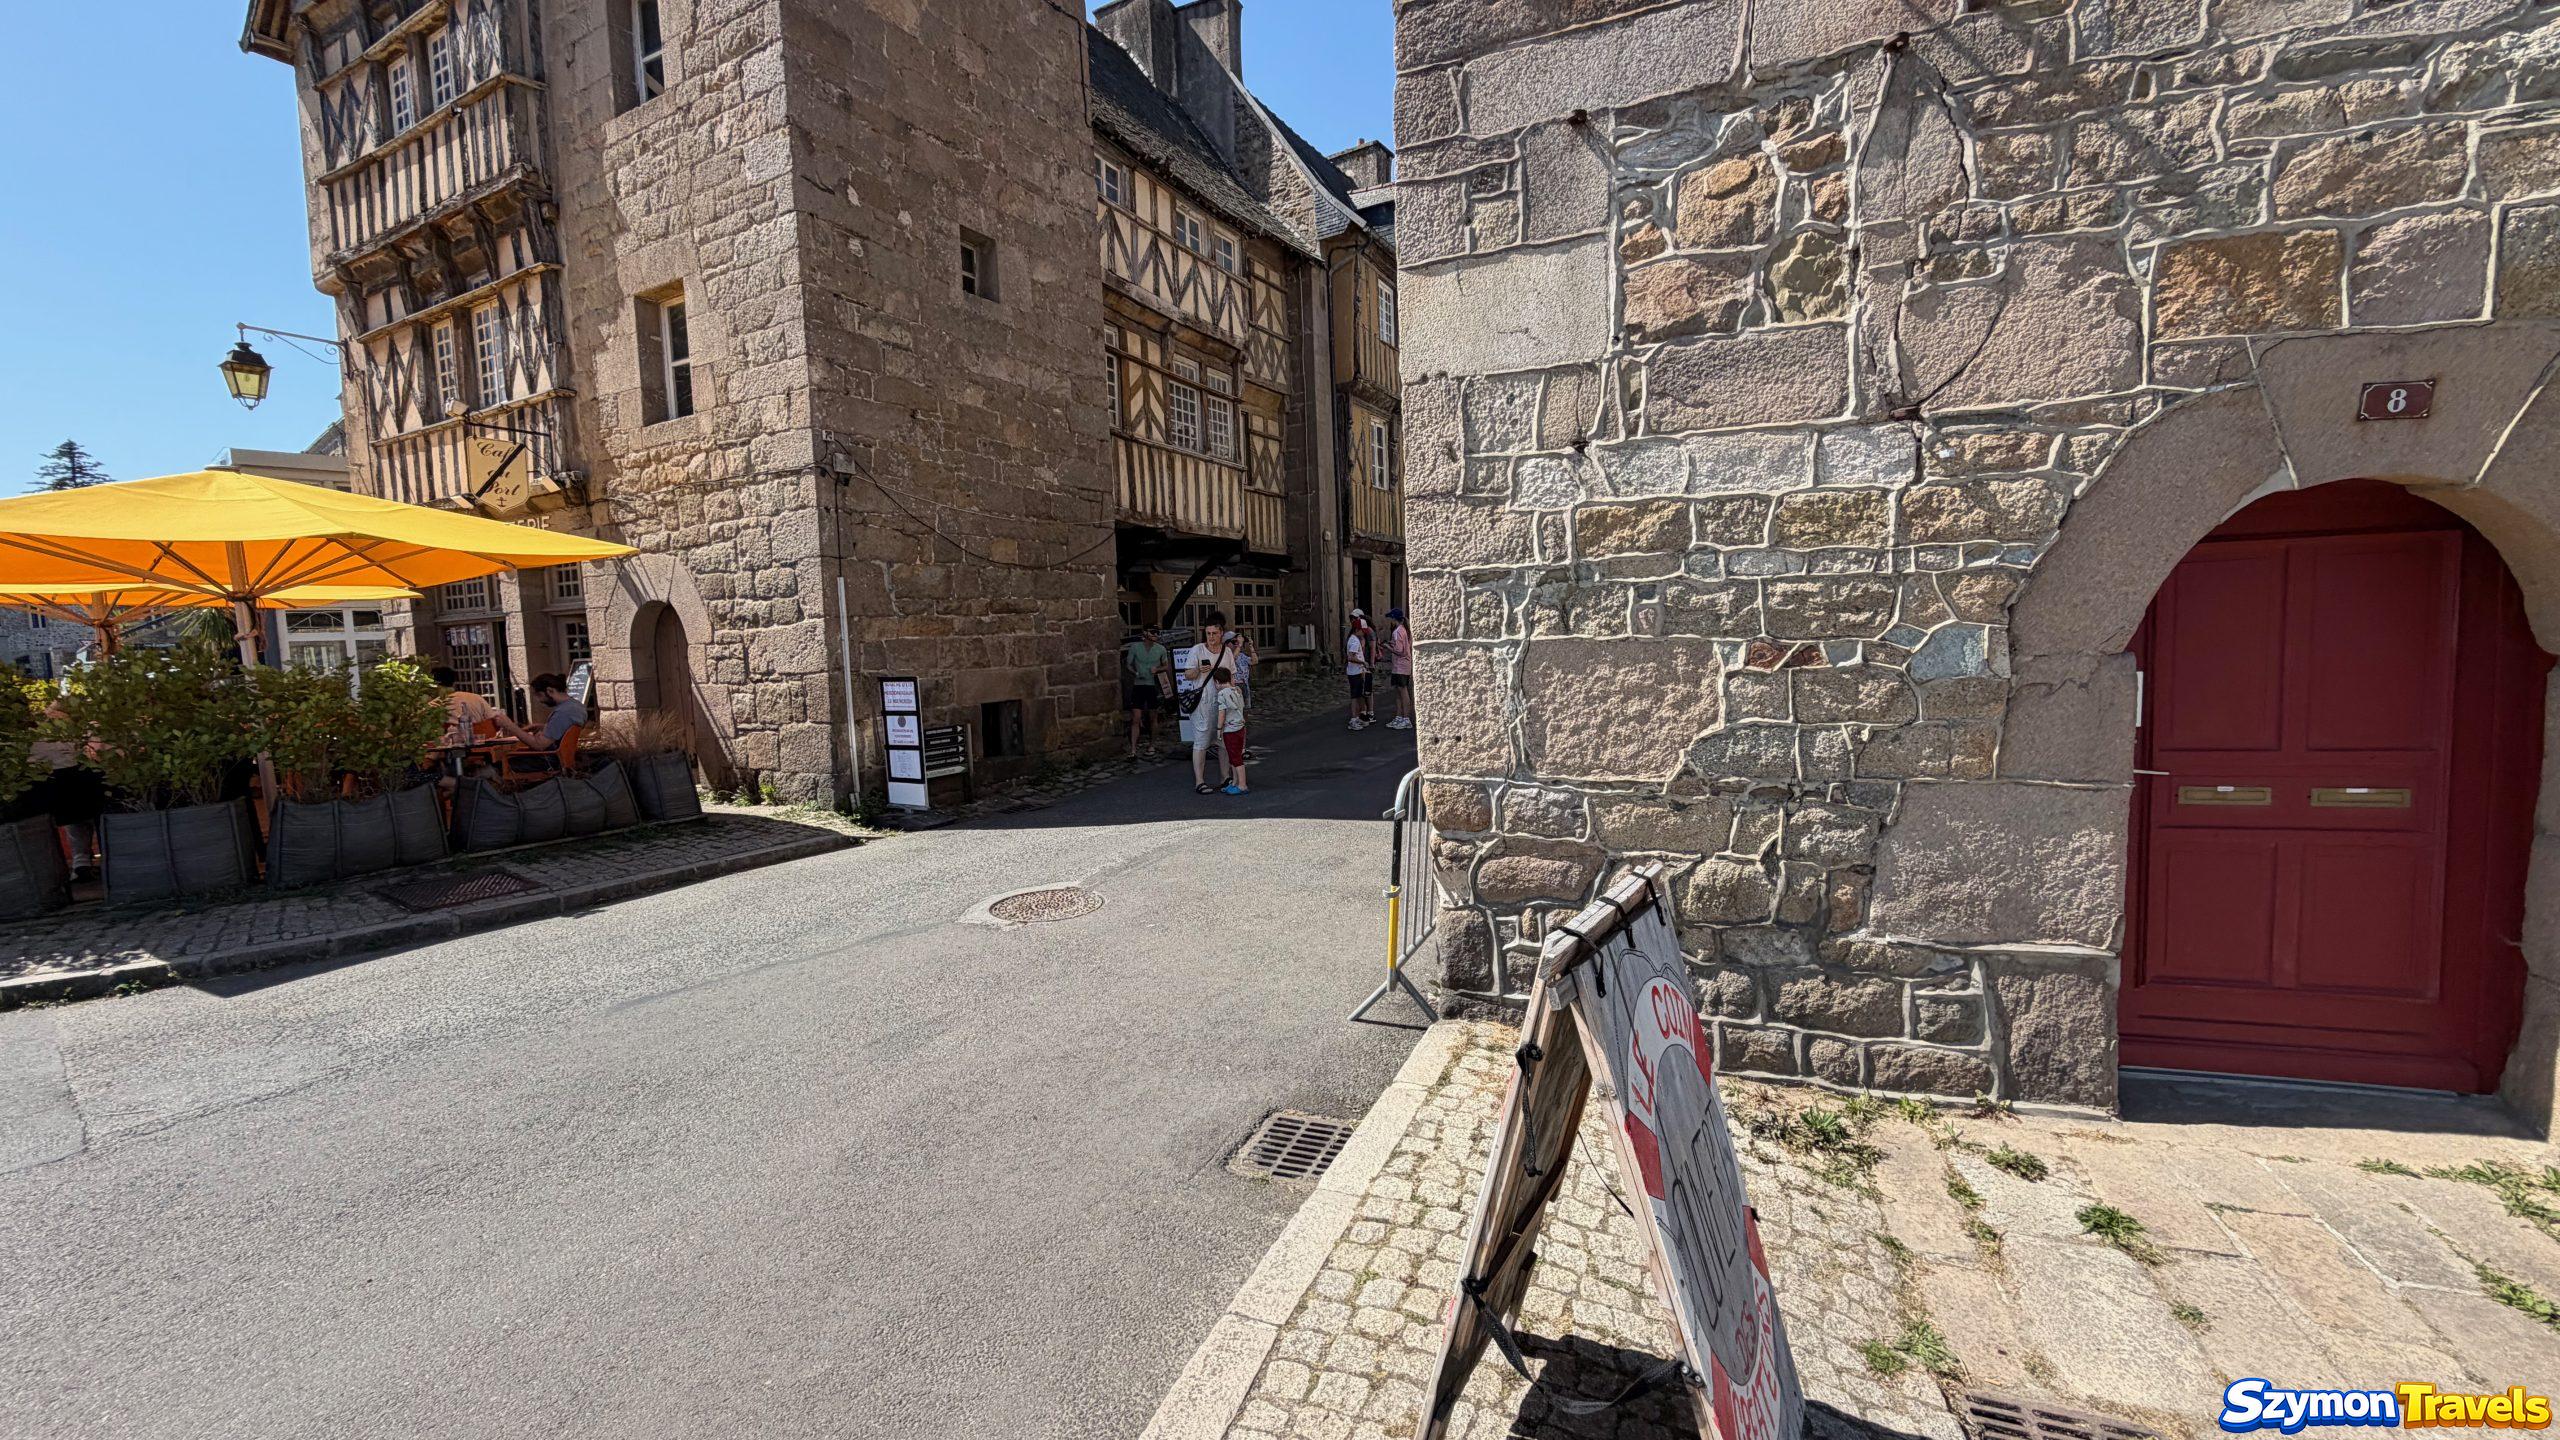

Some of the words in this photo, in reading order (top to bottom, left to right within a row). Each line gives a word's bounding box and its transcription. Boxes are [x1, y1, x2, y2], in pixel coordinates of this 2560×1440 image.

[2387, 388, 2407, 413] 8
[477, 442, 515, 463] Caf
[1631, 1029, 1655, 1117] LE
[1651, 983, 1696, 1053] COIN
[1672, 1099, 1740, 1332] OUVERT
[1735, 1300, 1757, 1376] DES
